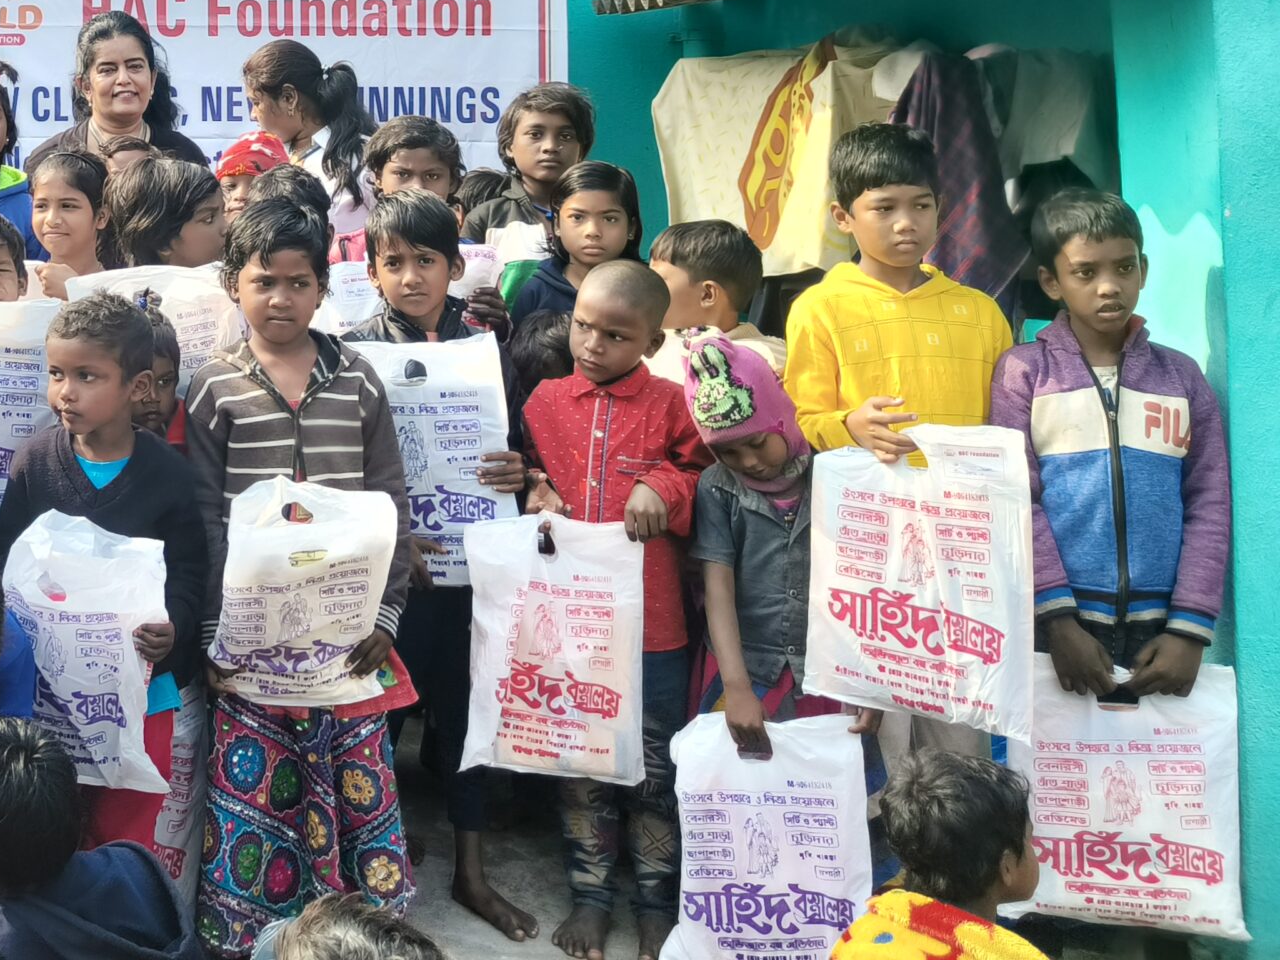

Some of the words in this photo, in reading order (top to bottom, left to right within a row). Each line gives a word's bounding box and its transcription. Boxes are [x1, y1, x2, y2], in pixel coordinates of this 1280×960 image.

[564, 671, 623, 720] বস্ত্রালয়
[1036, 742, 1072, 752] উৎসবে
[1116, 744, 1123, 752] ও
[1037, 760, 1084, 772] বেনারসী
[682, 793, 713, 803] উৎসবে
[685, 812, 727, 823] বেনারসী
[1037, 813, 1087, 825] রেডিমেড
[1149, 833, 1225, 886] বস্ত্রালয়
[688, 866, 734, 877] রেডিমেড
[788, 883, 856, 931] বস্ত্রালয়
